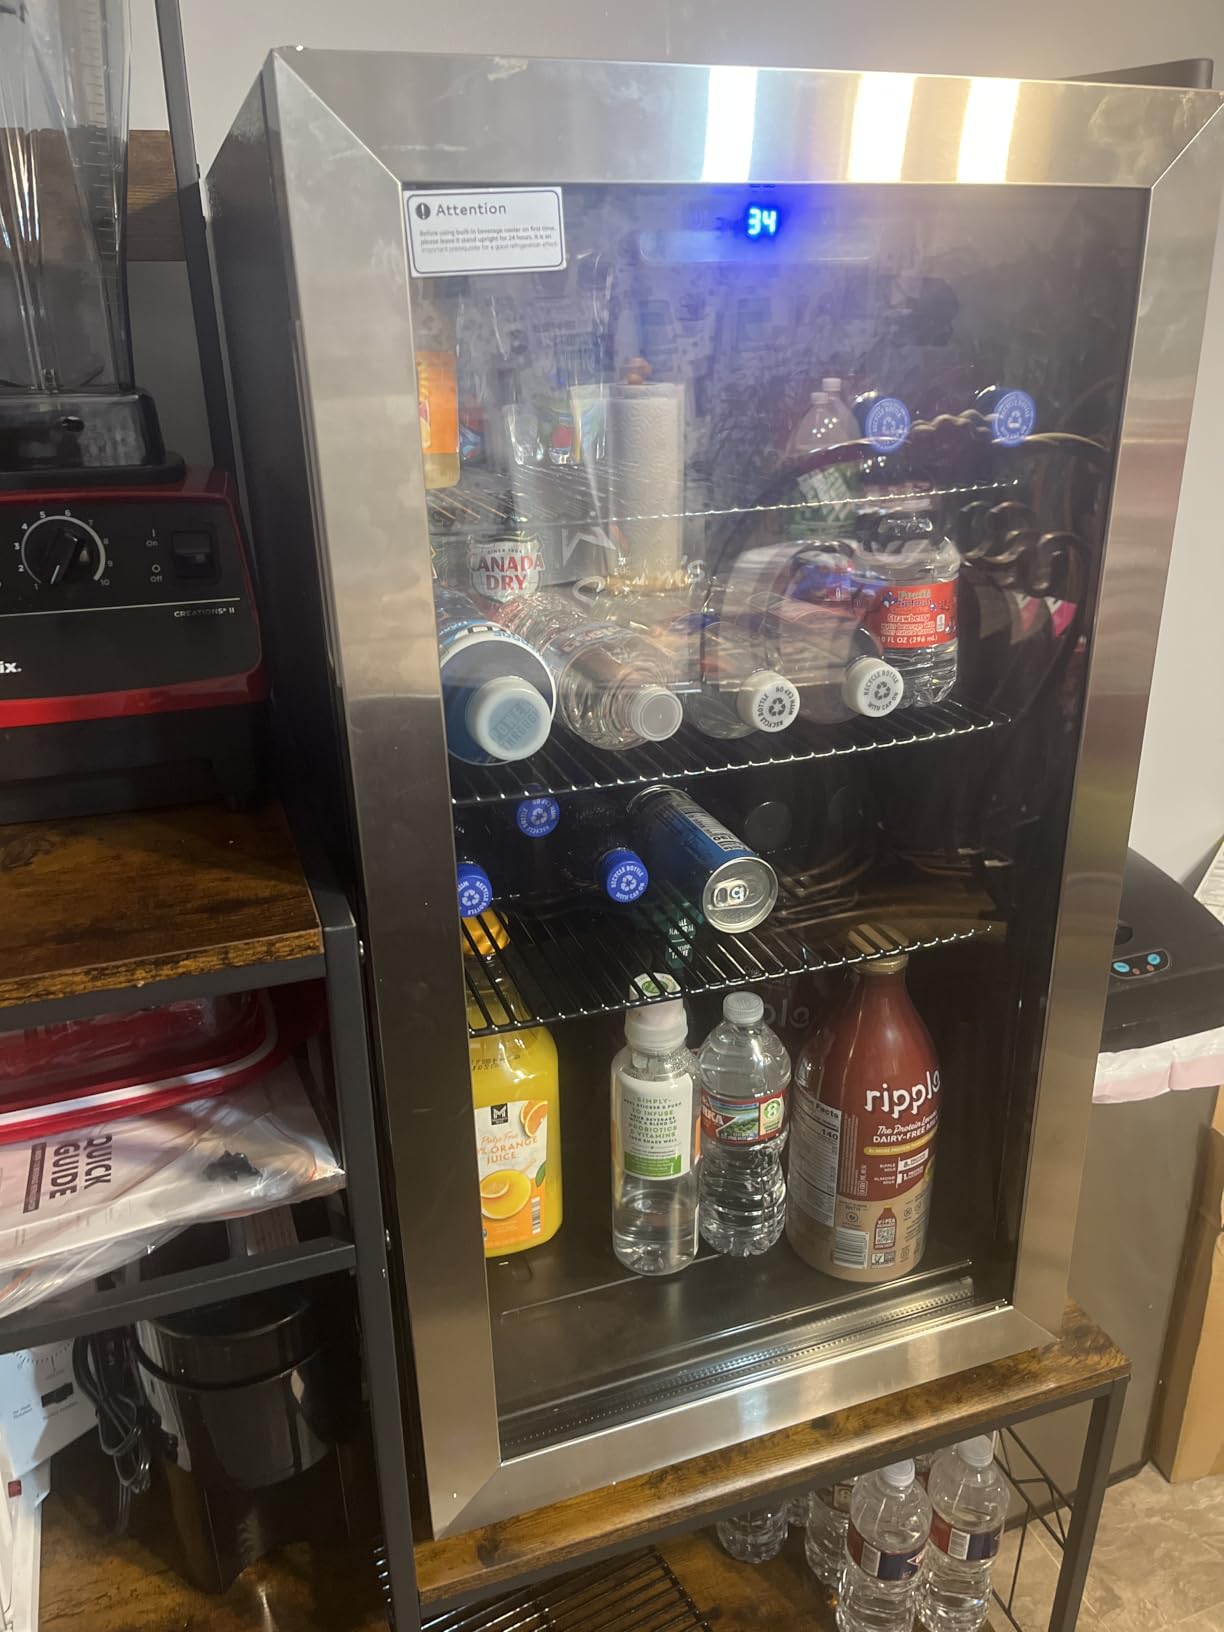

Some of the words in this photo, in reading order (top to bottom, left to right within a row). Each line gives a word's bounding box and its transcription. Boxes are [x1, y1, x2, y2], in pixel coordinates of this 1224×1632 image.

[436, 203, 507, 216] Attention
[747, 207, 777, 235] 34
[64, 509, 71, 517] 6
[13, 542, 20, 550] 3
[485, 575, 527, 590] DRY
[896, 635, 907, 643] OZ
[863, 672, 880, 696] RECYCLE
[881, 670, 899, 684] BOTTLE
[757, 692, 769, 717] BOTTLE
[760, 716, 783, 728] RECYCLE
[611, 866, 625, 888] RECYCLE
[626, 865, 644, 877] BOTTLE
[864, 1070, 941, 1119] ripple
[644, 1109, 674, 1117] INFUSE
[637, 1131, 677, 1139] VITAMINS
[820, 1128, 839, 1141] 140
[873, 1126, 925, 1143] DAIRY-FREE
[877, 1125, 893, 1135] The
[893, 1120, 921, 1135] Protein
[490, 1137, 538, 1154] ORANGE
[83, 1133, 112, 1190] QUICK
[486, 1152, 517, 1167] JUICE
[49, 1142, 81, 1200] GUIDE
